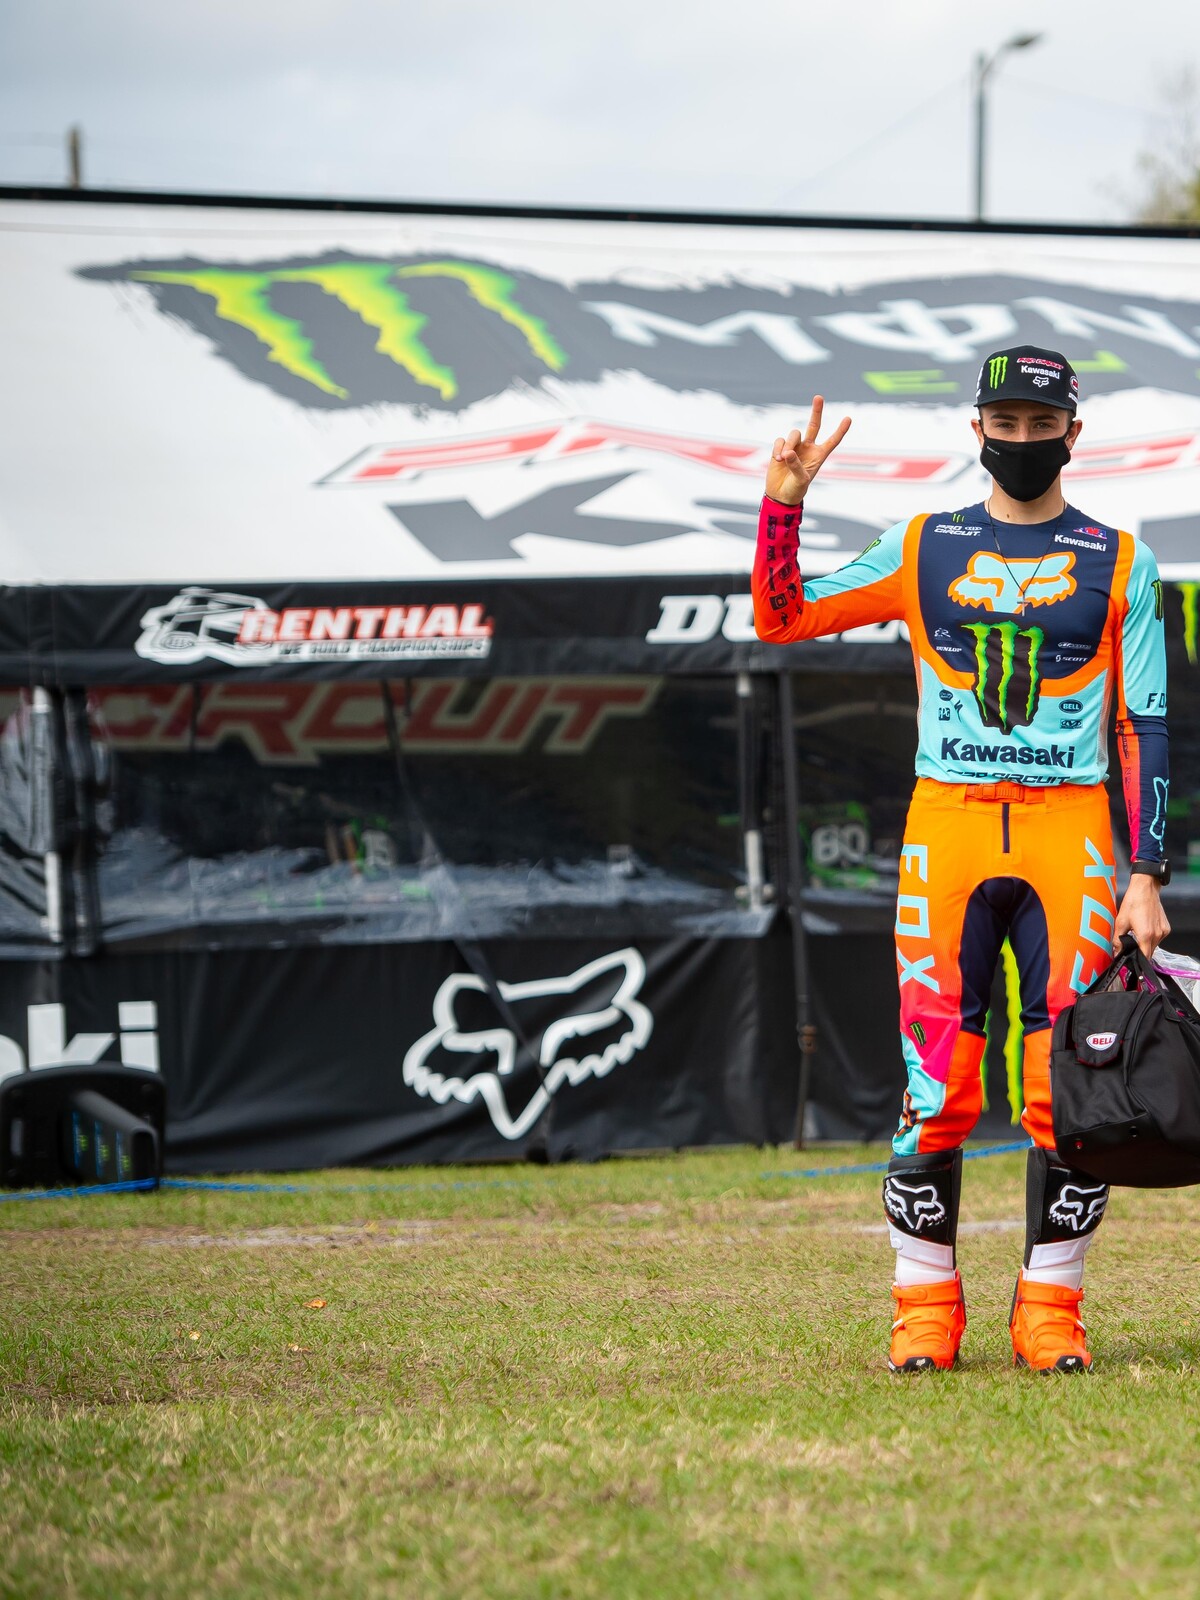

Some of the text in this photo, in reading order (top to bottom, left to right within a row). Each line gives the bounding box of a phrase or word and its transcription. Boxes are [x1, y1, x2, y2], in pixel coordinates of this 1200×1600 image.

[1020, 364, 1060, 380] Kawasaki
[934, 528, 981, 537] CIRCUIT
[1054, 534, 1107, 552] Kawasaki
[236, 603, 493, 643] RENTHAL
[935, 645, 963, 653] DUNLOP
[1062, 703, 1080, 711] BELL
[941, 737, 1075, 769] Kawasaki
[991, 772, 1071, 785] CIRCUIT
[896, 843, 941, 995] FOX
[1092, 1036, 1113, 1046] BELL
